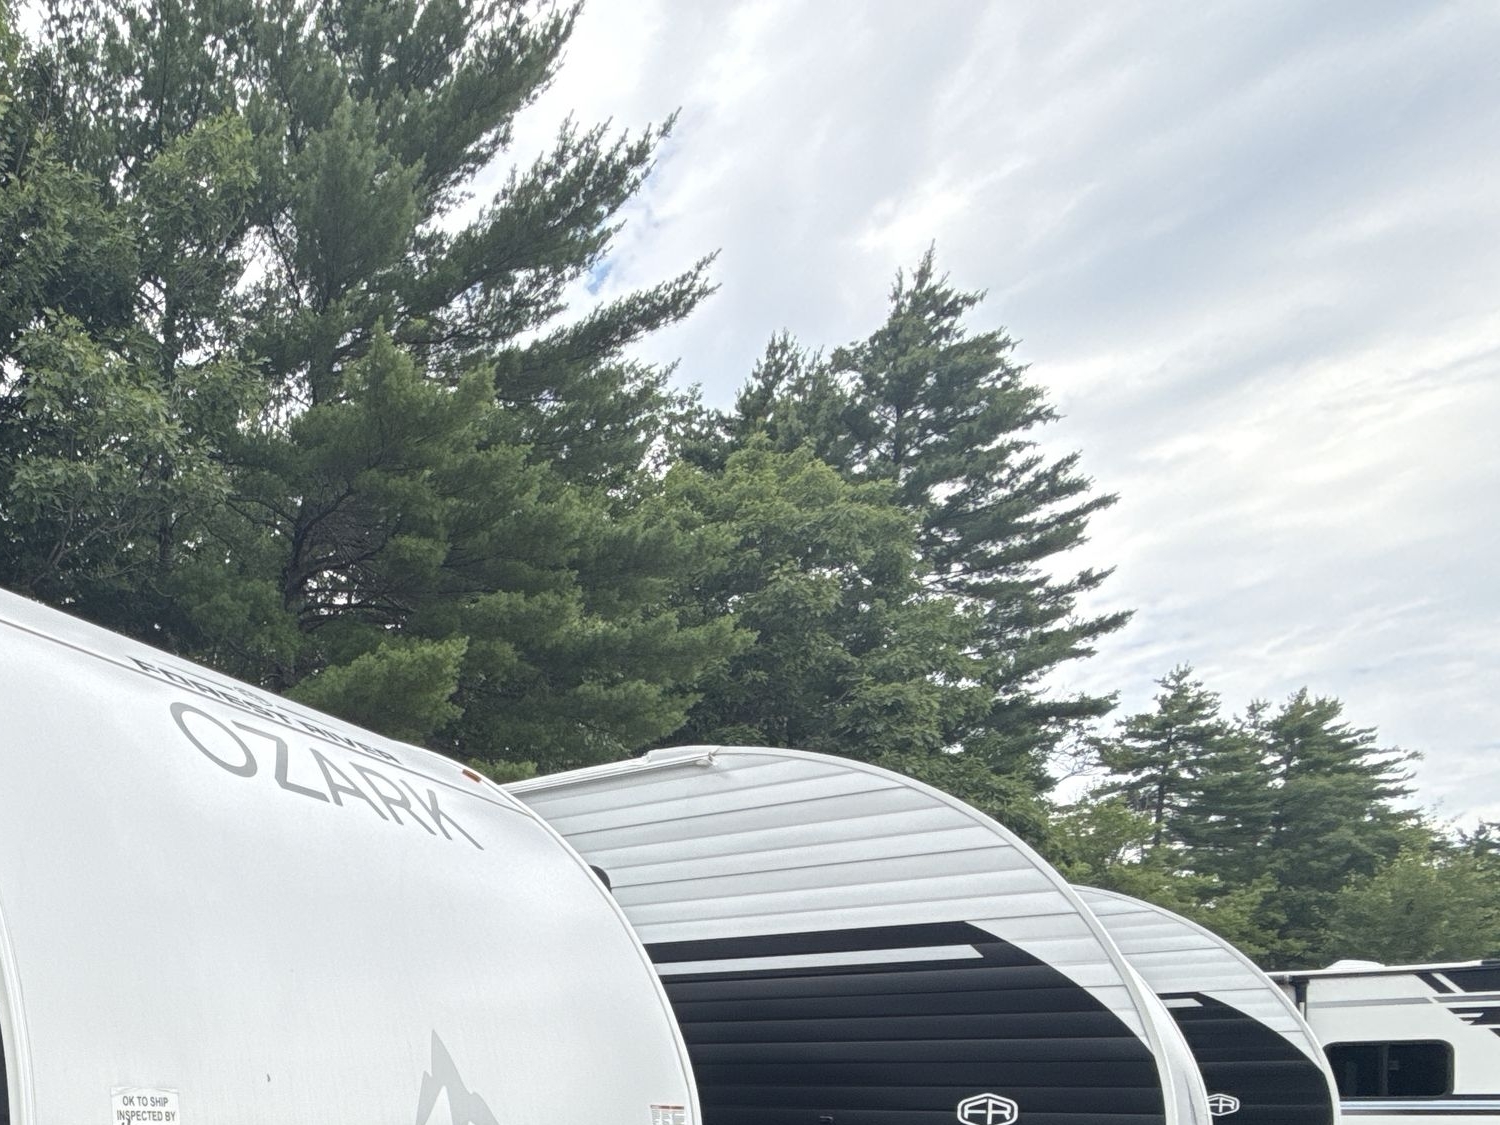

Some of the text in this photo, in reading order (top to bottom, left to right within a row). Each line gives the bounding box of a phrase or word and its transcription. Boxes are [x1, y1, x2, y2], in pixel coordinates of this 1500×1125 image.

[126, 655, 404, 765] FOREST RIVER
[170, 702, 484, 851] OZARK
[117, 1109, 176, 1121] INSPECTED BY
[122, 1095, 169, 1107] OK TO SHIP
